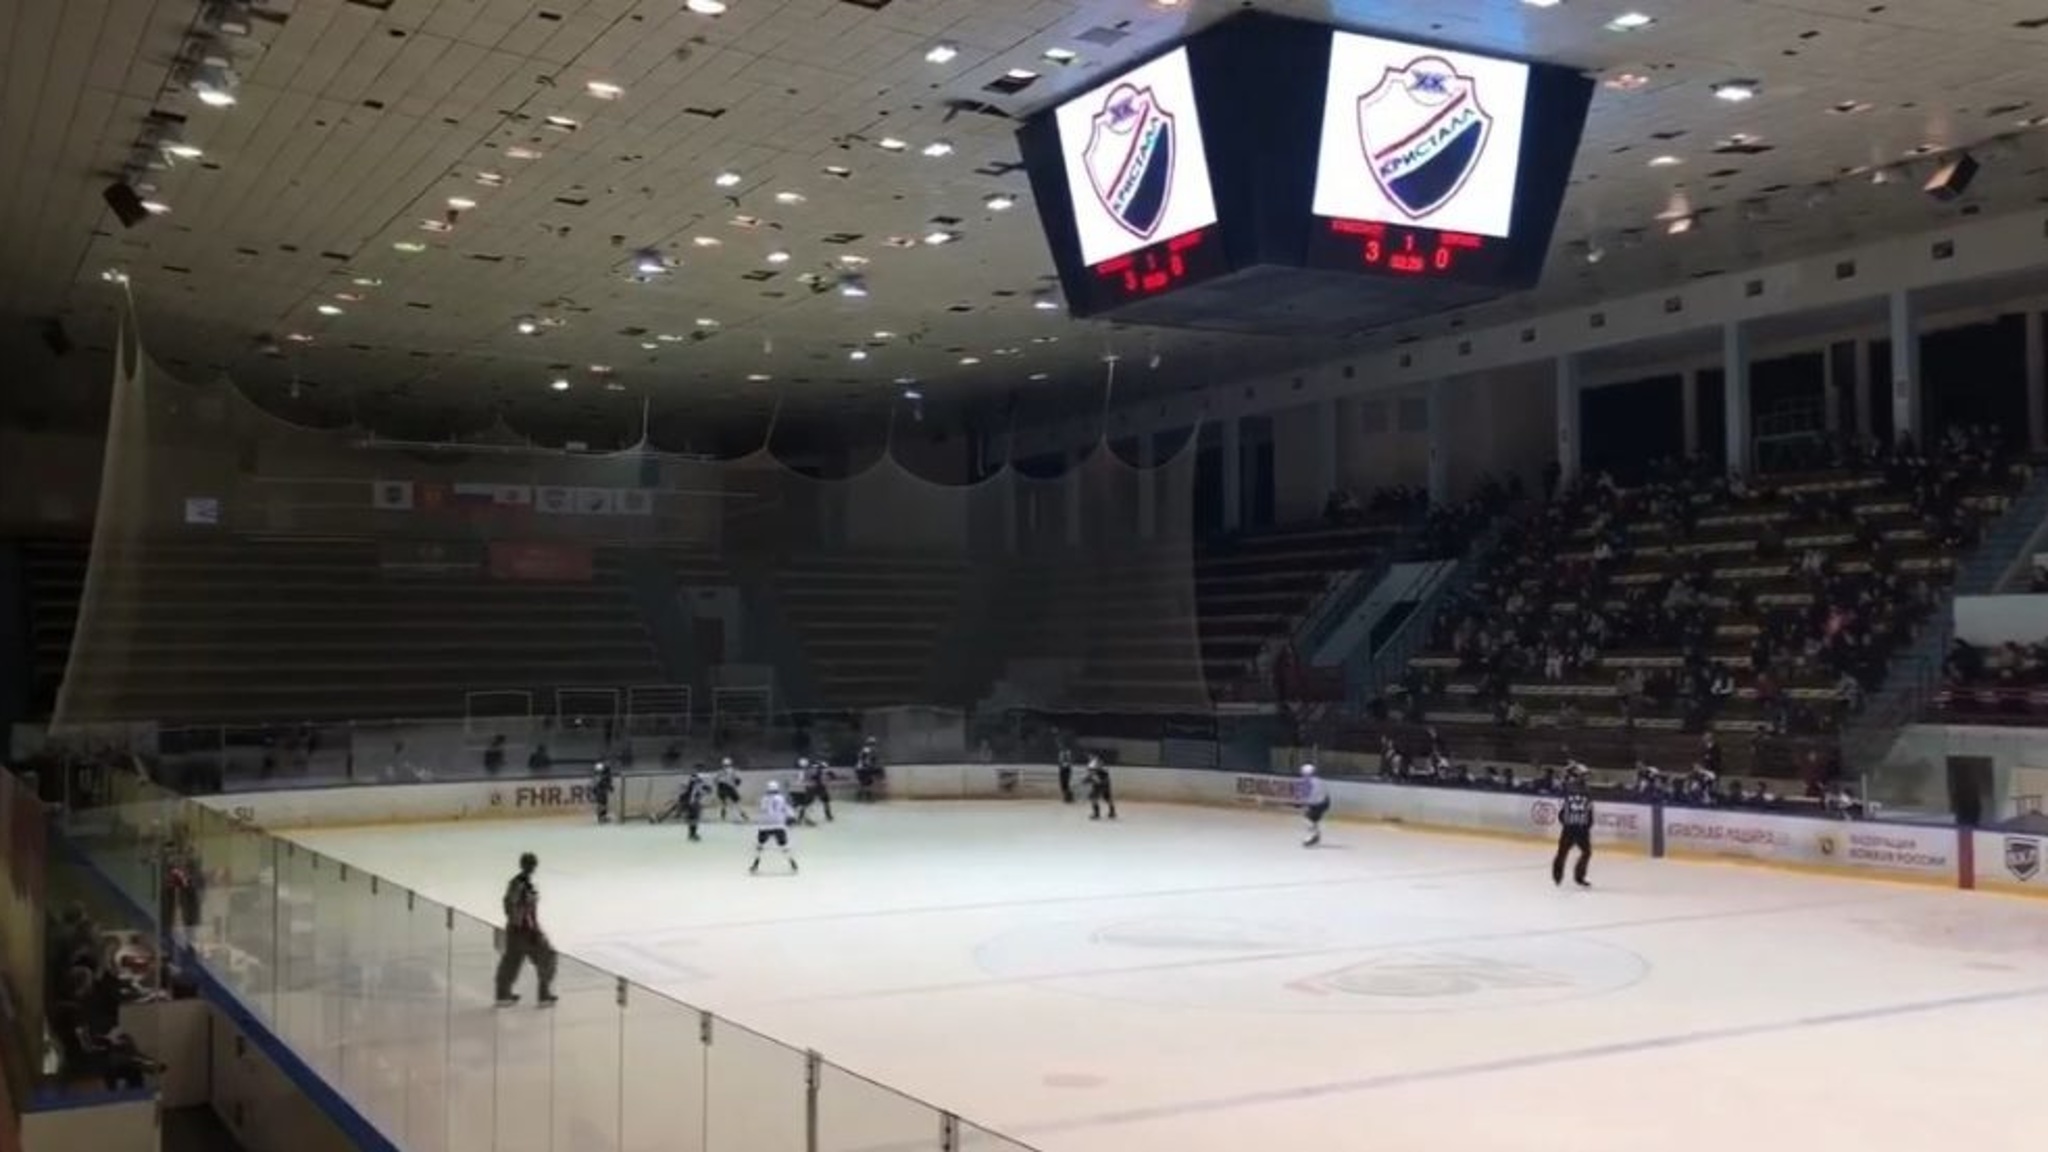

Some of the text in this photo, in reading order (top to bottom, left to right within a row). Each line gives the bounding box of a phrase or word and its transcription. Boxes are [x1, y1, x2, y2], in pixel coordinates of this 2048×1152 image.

[1112, 116, 1159, 213] КРИСТАЛЛ
[1380, 107, 1476, 179] КРИСТАЛЛ
[1365, 240, 1380, 262] 3
[1434, 249, 1449, 269] 0
